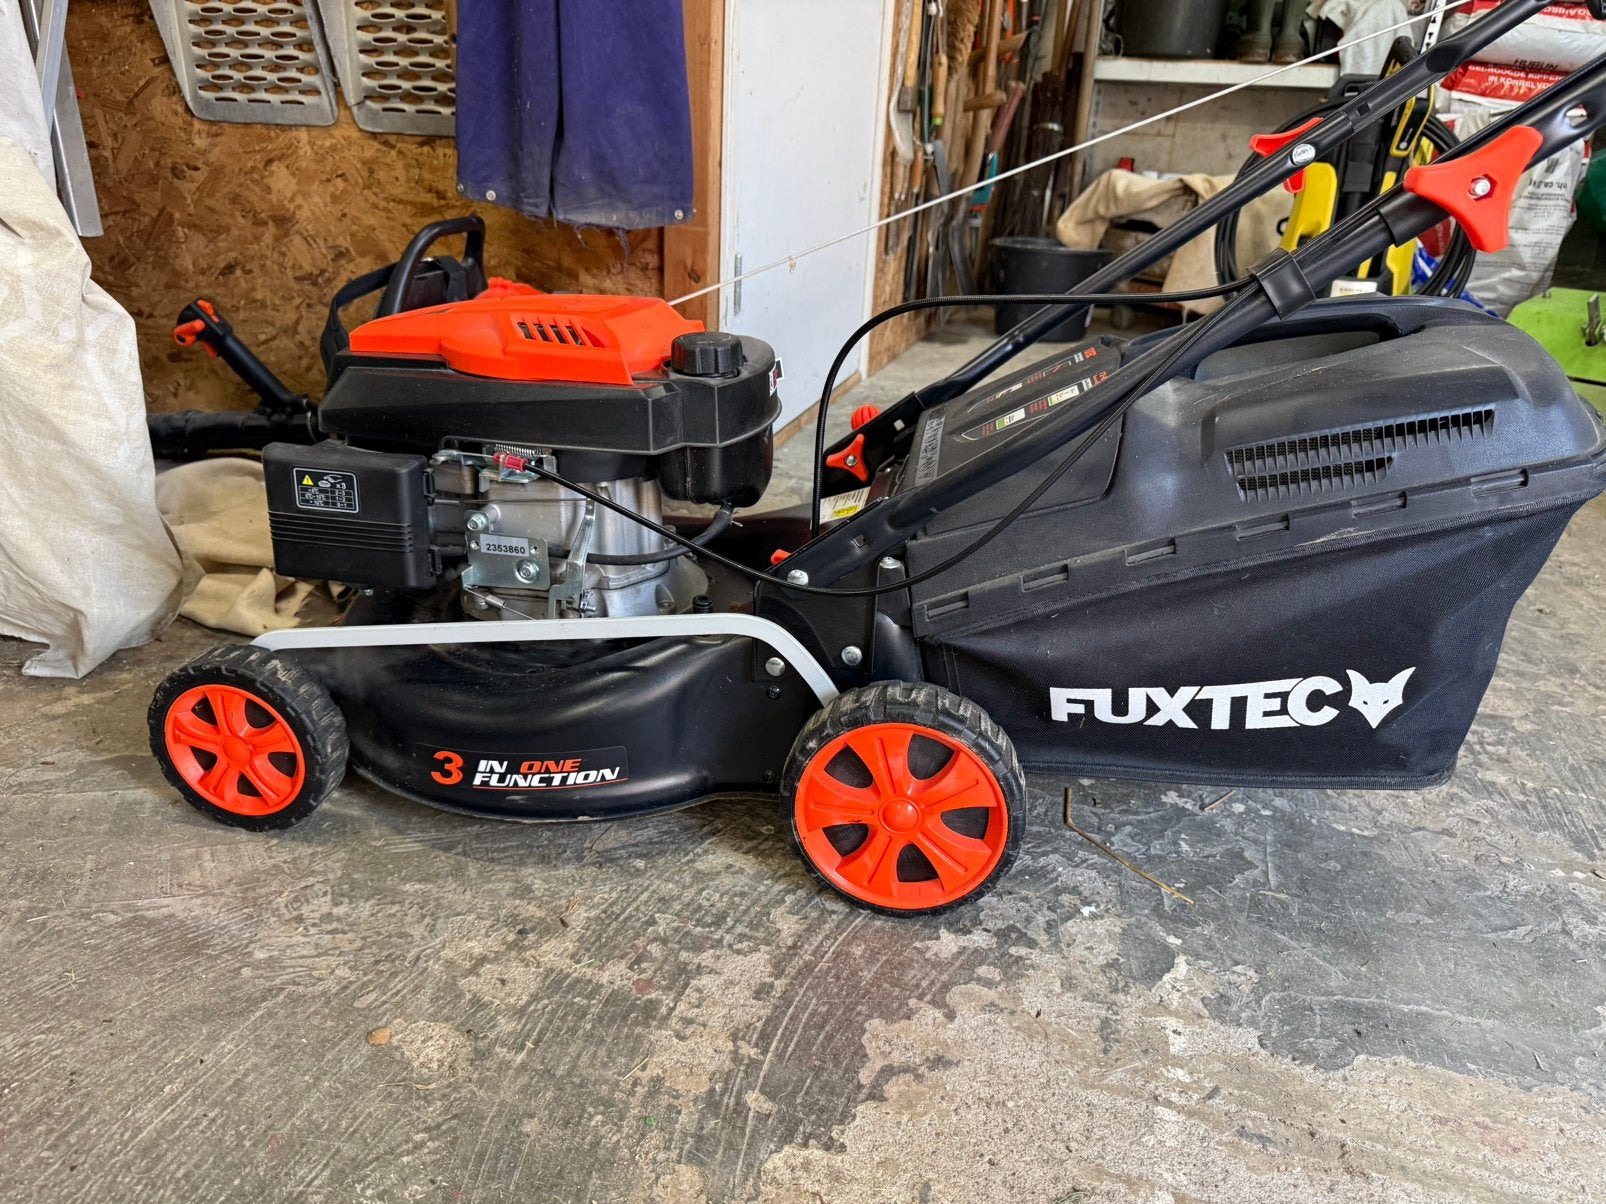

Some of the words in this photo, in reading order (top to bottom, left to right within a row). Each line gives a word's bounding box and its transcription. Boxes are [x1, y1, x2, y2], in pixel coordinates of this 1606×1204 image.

[486, 543, 526, 554] 2353860
[1048, 675, 1344, 730] FUXTEC
[430, 750, 464, 785] 3
[477, 759, 509, 773] IN
[519, 758, 583, 774] ONE
[472, 766, 621, 787] FUNCTION
